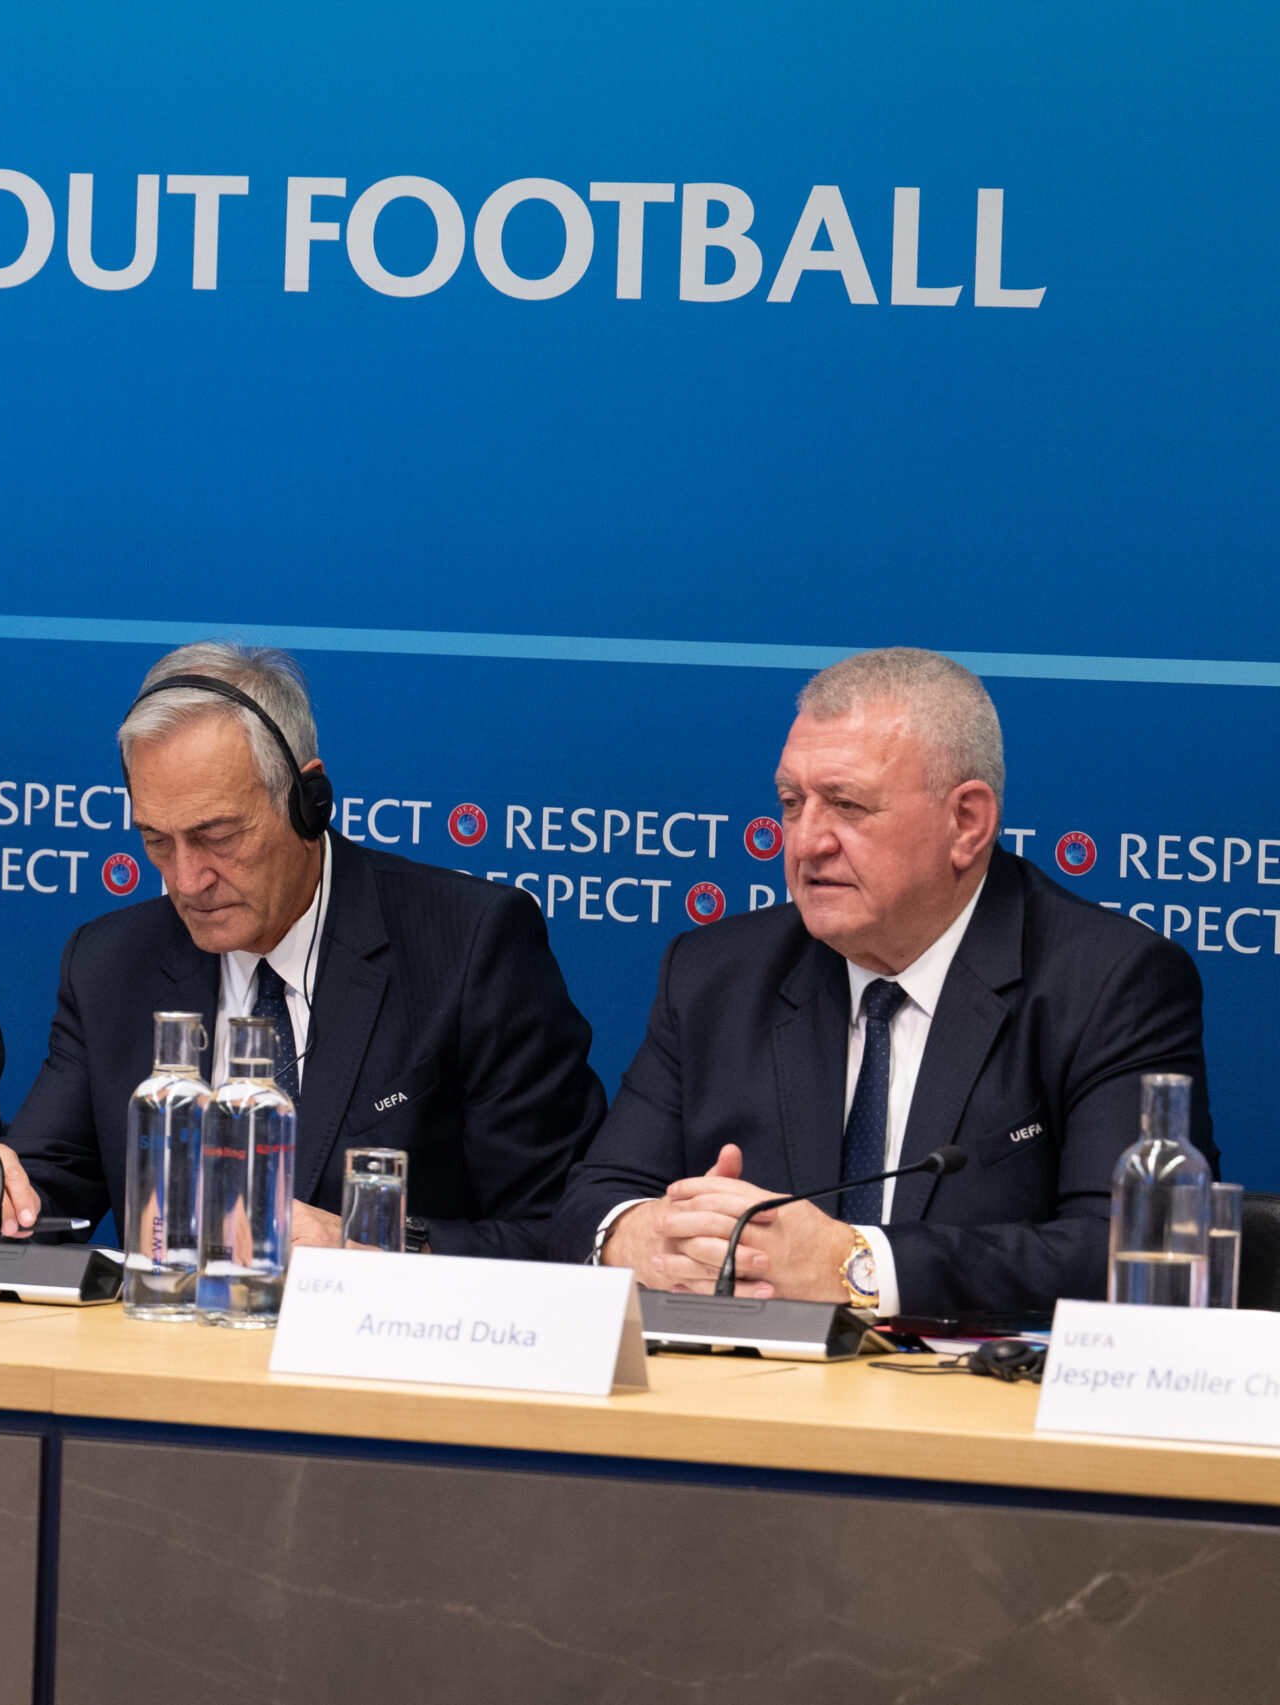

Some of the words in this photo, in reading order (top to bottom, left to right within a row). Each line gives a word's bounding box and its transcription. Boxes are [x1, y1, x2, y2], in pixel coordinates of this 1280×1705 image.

[284, 175, 1047, 308] FOOTBALL
[506, 805, 729, 858] RESPECT
[1120, 833, 1280, 884] RESPE
[453, 869, 671, 923] SPECT
[1099, 902, 1280, 955] SPECT
[374, 1091, 408, 1111] UEFA
[1009, 1122, 1043, 1142] UEFA
[297, 1278, 345, 1294] UEFA
[357, 1314, 462, 1342] Armand
[470, 1320, 538, 1347] Duka
[1064, 1332, 1115, 1349] UEFA
[1051, 1362, 1138, 1392] Jesper
[1147, 1367, 1235, 1395] Møller
